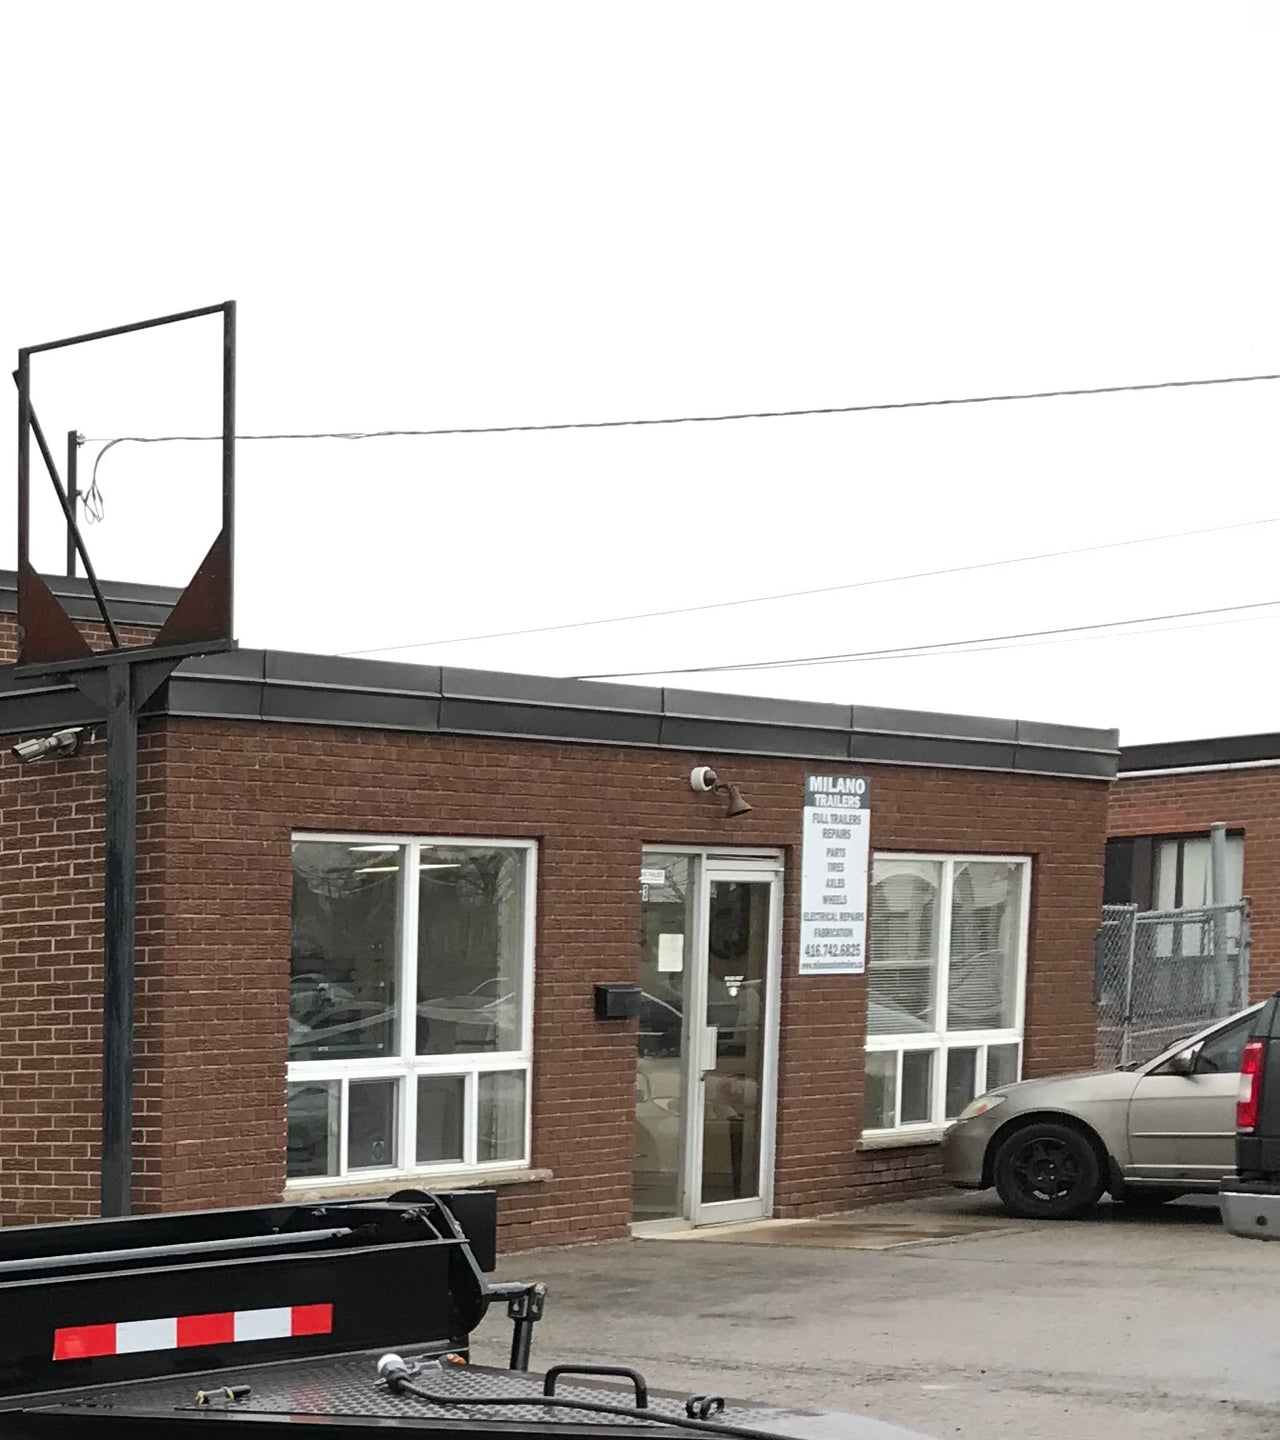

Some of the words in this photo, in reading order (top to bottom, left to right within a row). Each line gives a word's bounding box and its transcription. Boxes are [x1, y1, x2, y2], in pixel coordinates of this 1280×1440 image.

[810, 776, 866, 795] MILANO
[814, 794, 861, 808] TRAILERS
[812, 813, 829, 824] FULL
[830, 813, 861, 825] TRAILERS
[822, 828, 851, 840] REPAIRS
[826, 847, 846, 858] PARTS
[826, 862, 844, 872] TIRES
[822, 895, 847, 905] WHEELS
[803, 911, 838, 921] ELECTRICAL
[839, 911, 864, 921] REPAIRS
[805, 943, 861, 957] 416.742.6825
